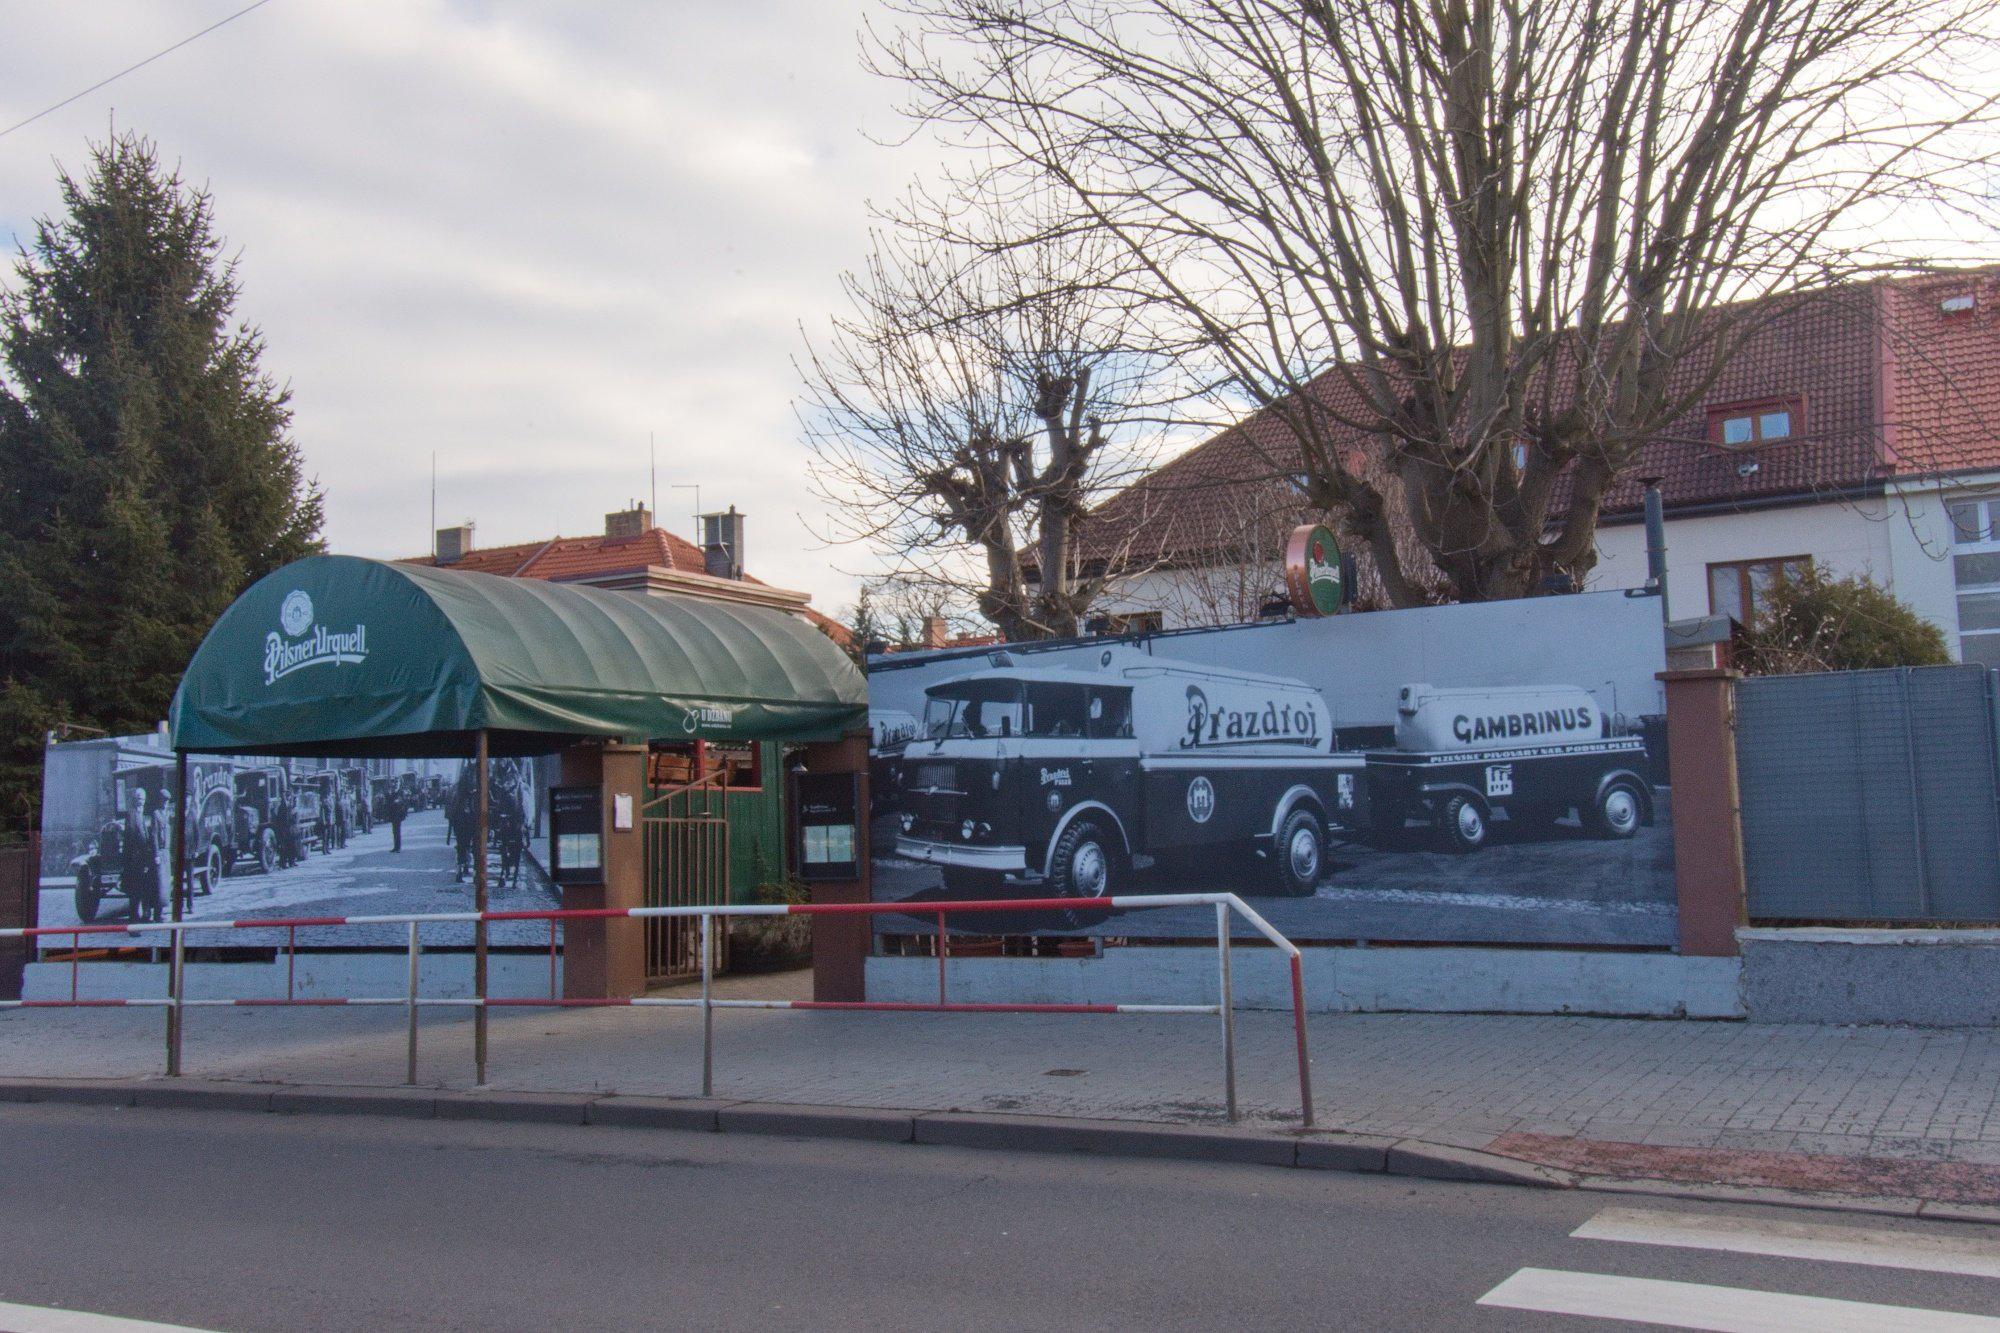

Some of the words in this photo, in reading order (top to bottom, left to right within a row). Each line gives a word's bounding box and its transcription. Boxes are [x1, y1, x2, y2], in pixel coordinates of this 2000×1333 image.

[264, 631, 317, 686] Pilsner
[314, 624, 366, 667] Urquell
[1180, 685, 1317, 748] Prazdroj
[1453, 707, 1592, 744] GAMBRINUS
